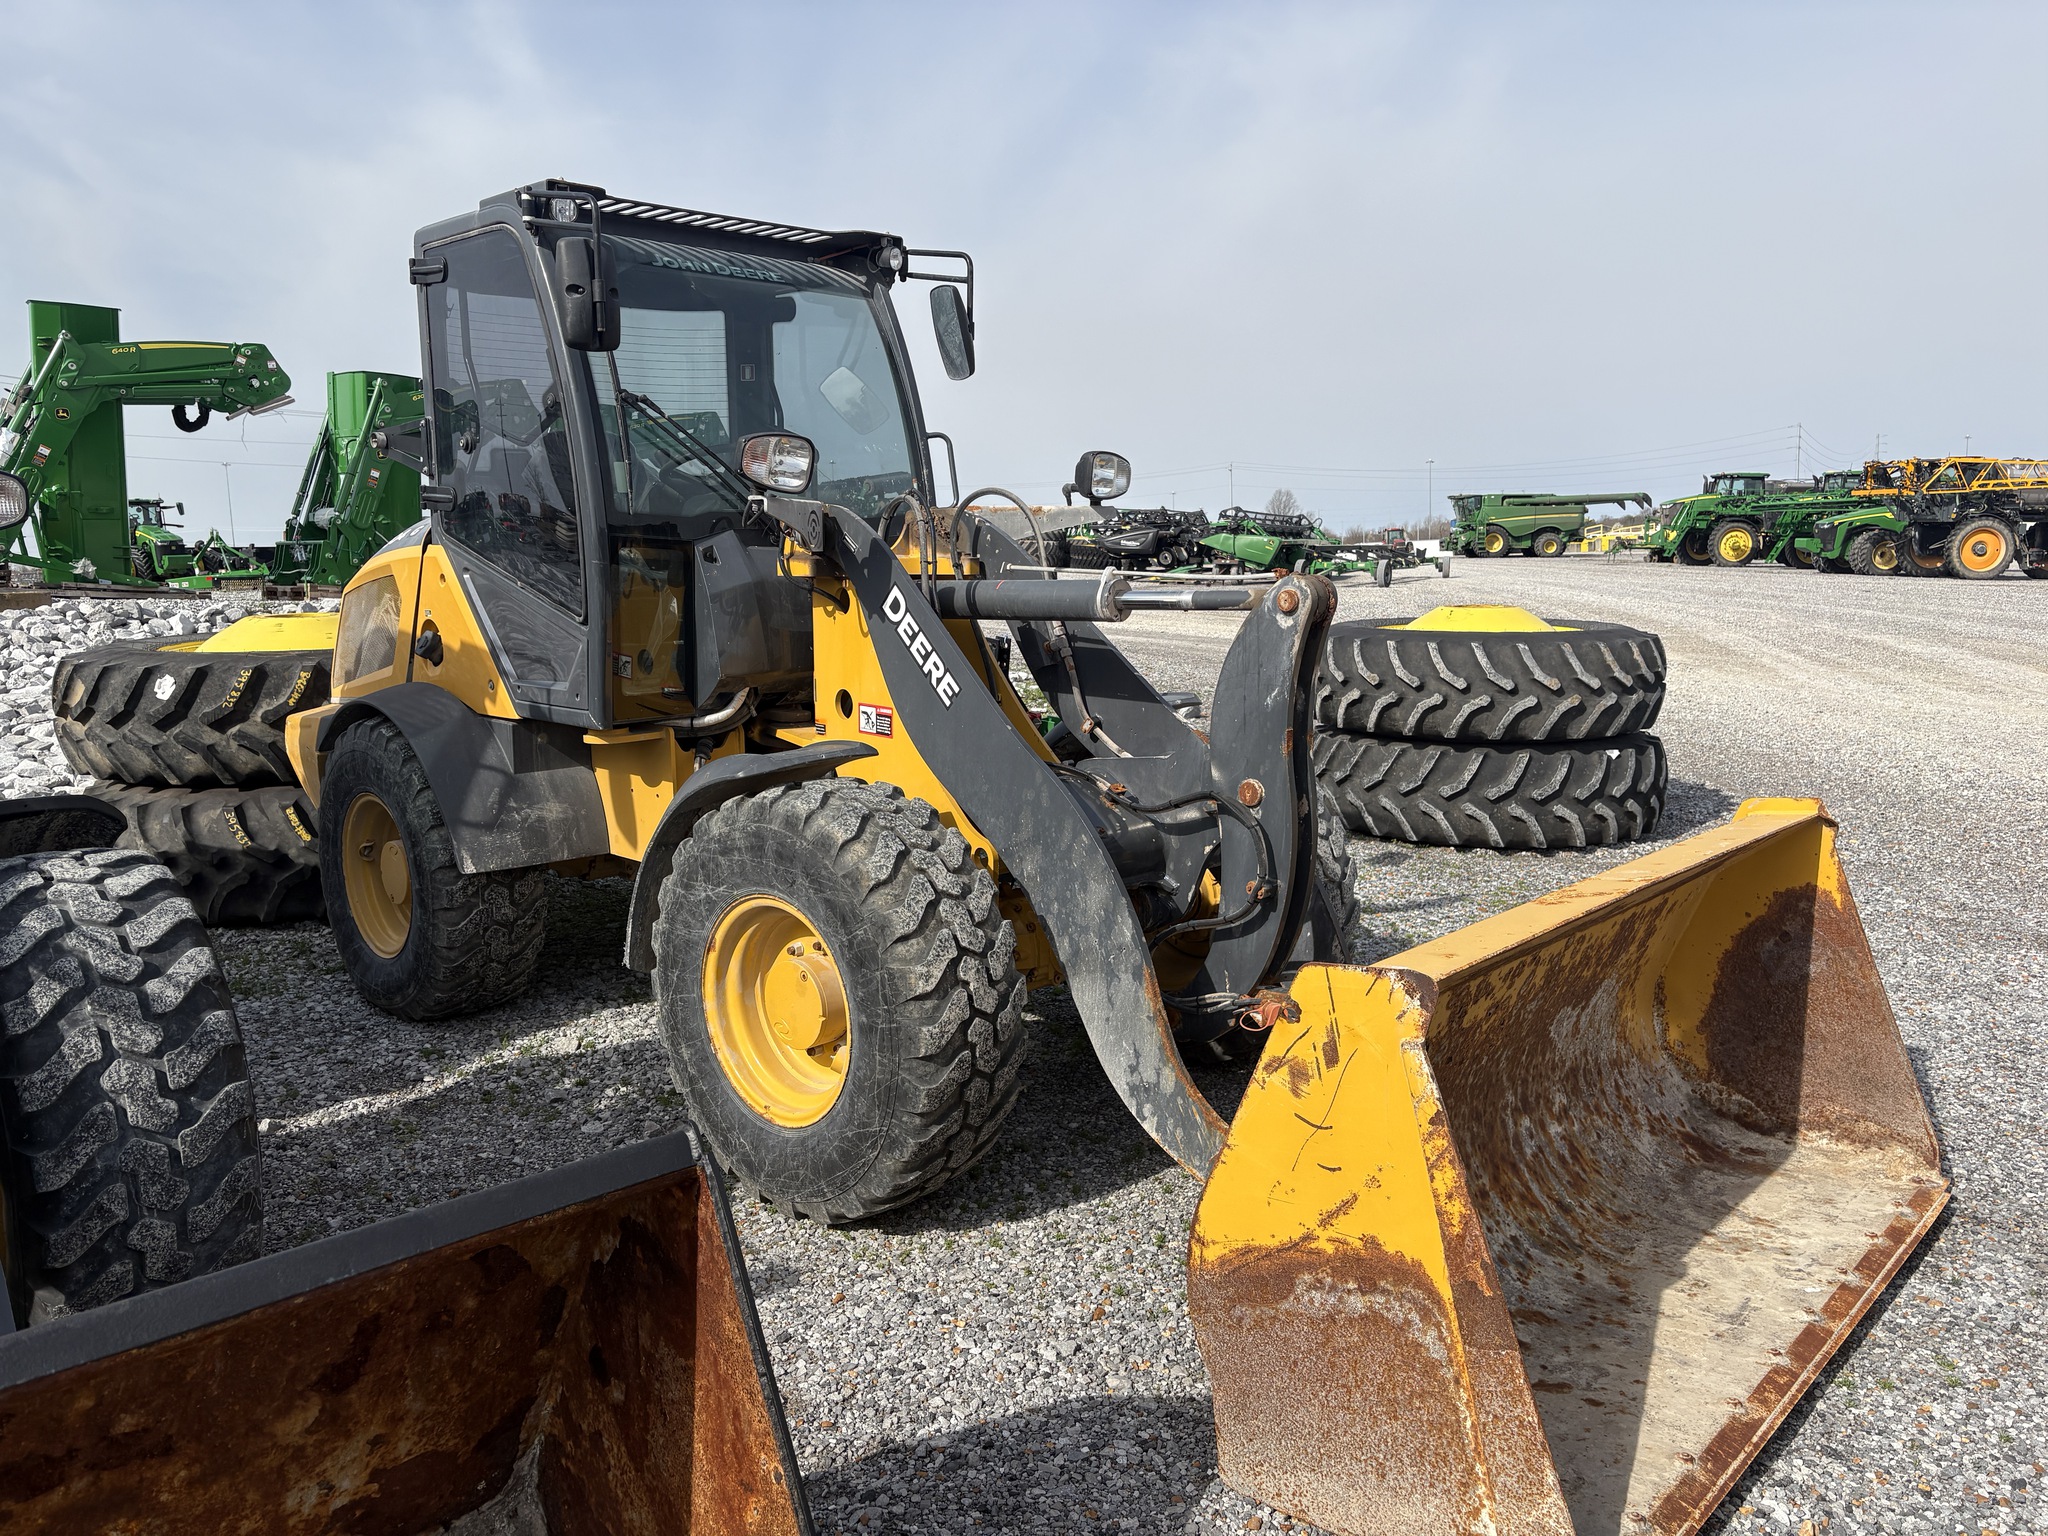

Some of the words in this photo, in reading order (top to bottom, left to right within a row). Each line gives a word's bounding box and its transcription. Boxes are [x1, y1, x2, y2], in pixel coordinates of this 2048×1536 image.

[651, 253, 711, 273] JOHN
[711, 262, 786, 283] DEERE
[111, 347, 129, 355] 640
[882, 584, 960, 708] DEERE
